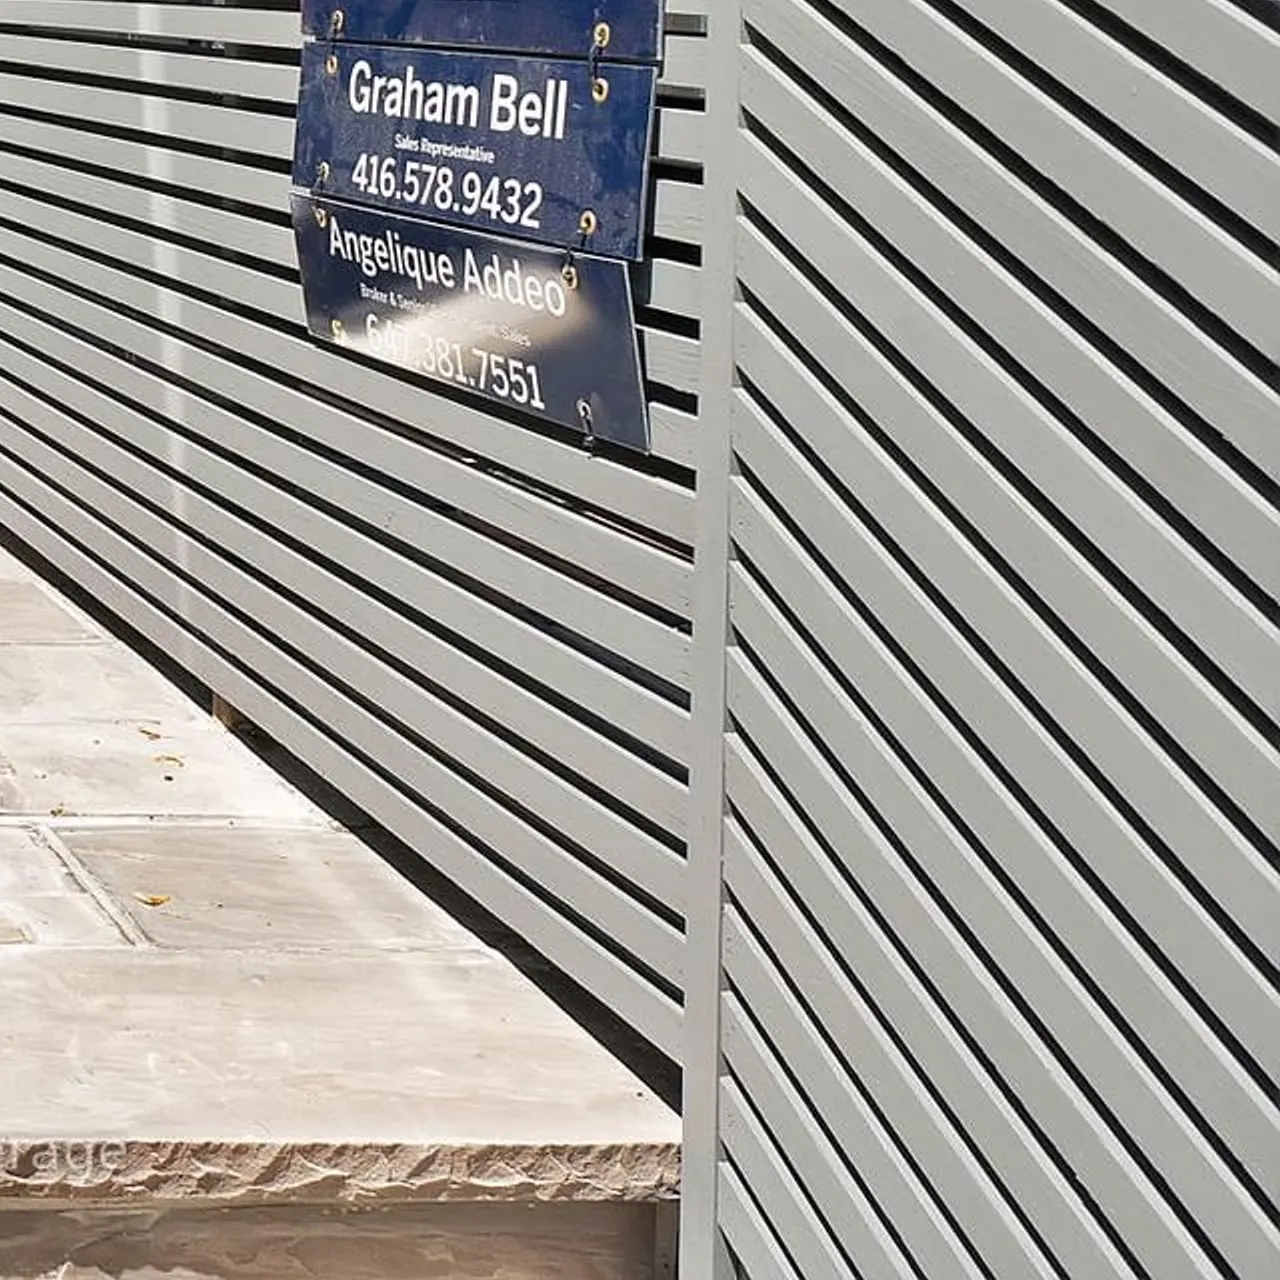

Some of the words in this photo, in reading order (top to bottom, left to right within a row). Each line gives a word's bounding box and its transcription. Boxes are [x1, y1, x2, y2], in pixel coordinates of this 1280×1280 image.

[349, 60, 480, 128] Graham
[490, 73, 568, 140] Bell
[394, 133, 420, 152] Sales
[420, 137, 495, 164] Representative
[352, 153, 544, 229] 416.578.9432
[330, 216, 455, 290] Angelique
[463, 248, 566, 317] Addeo
